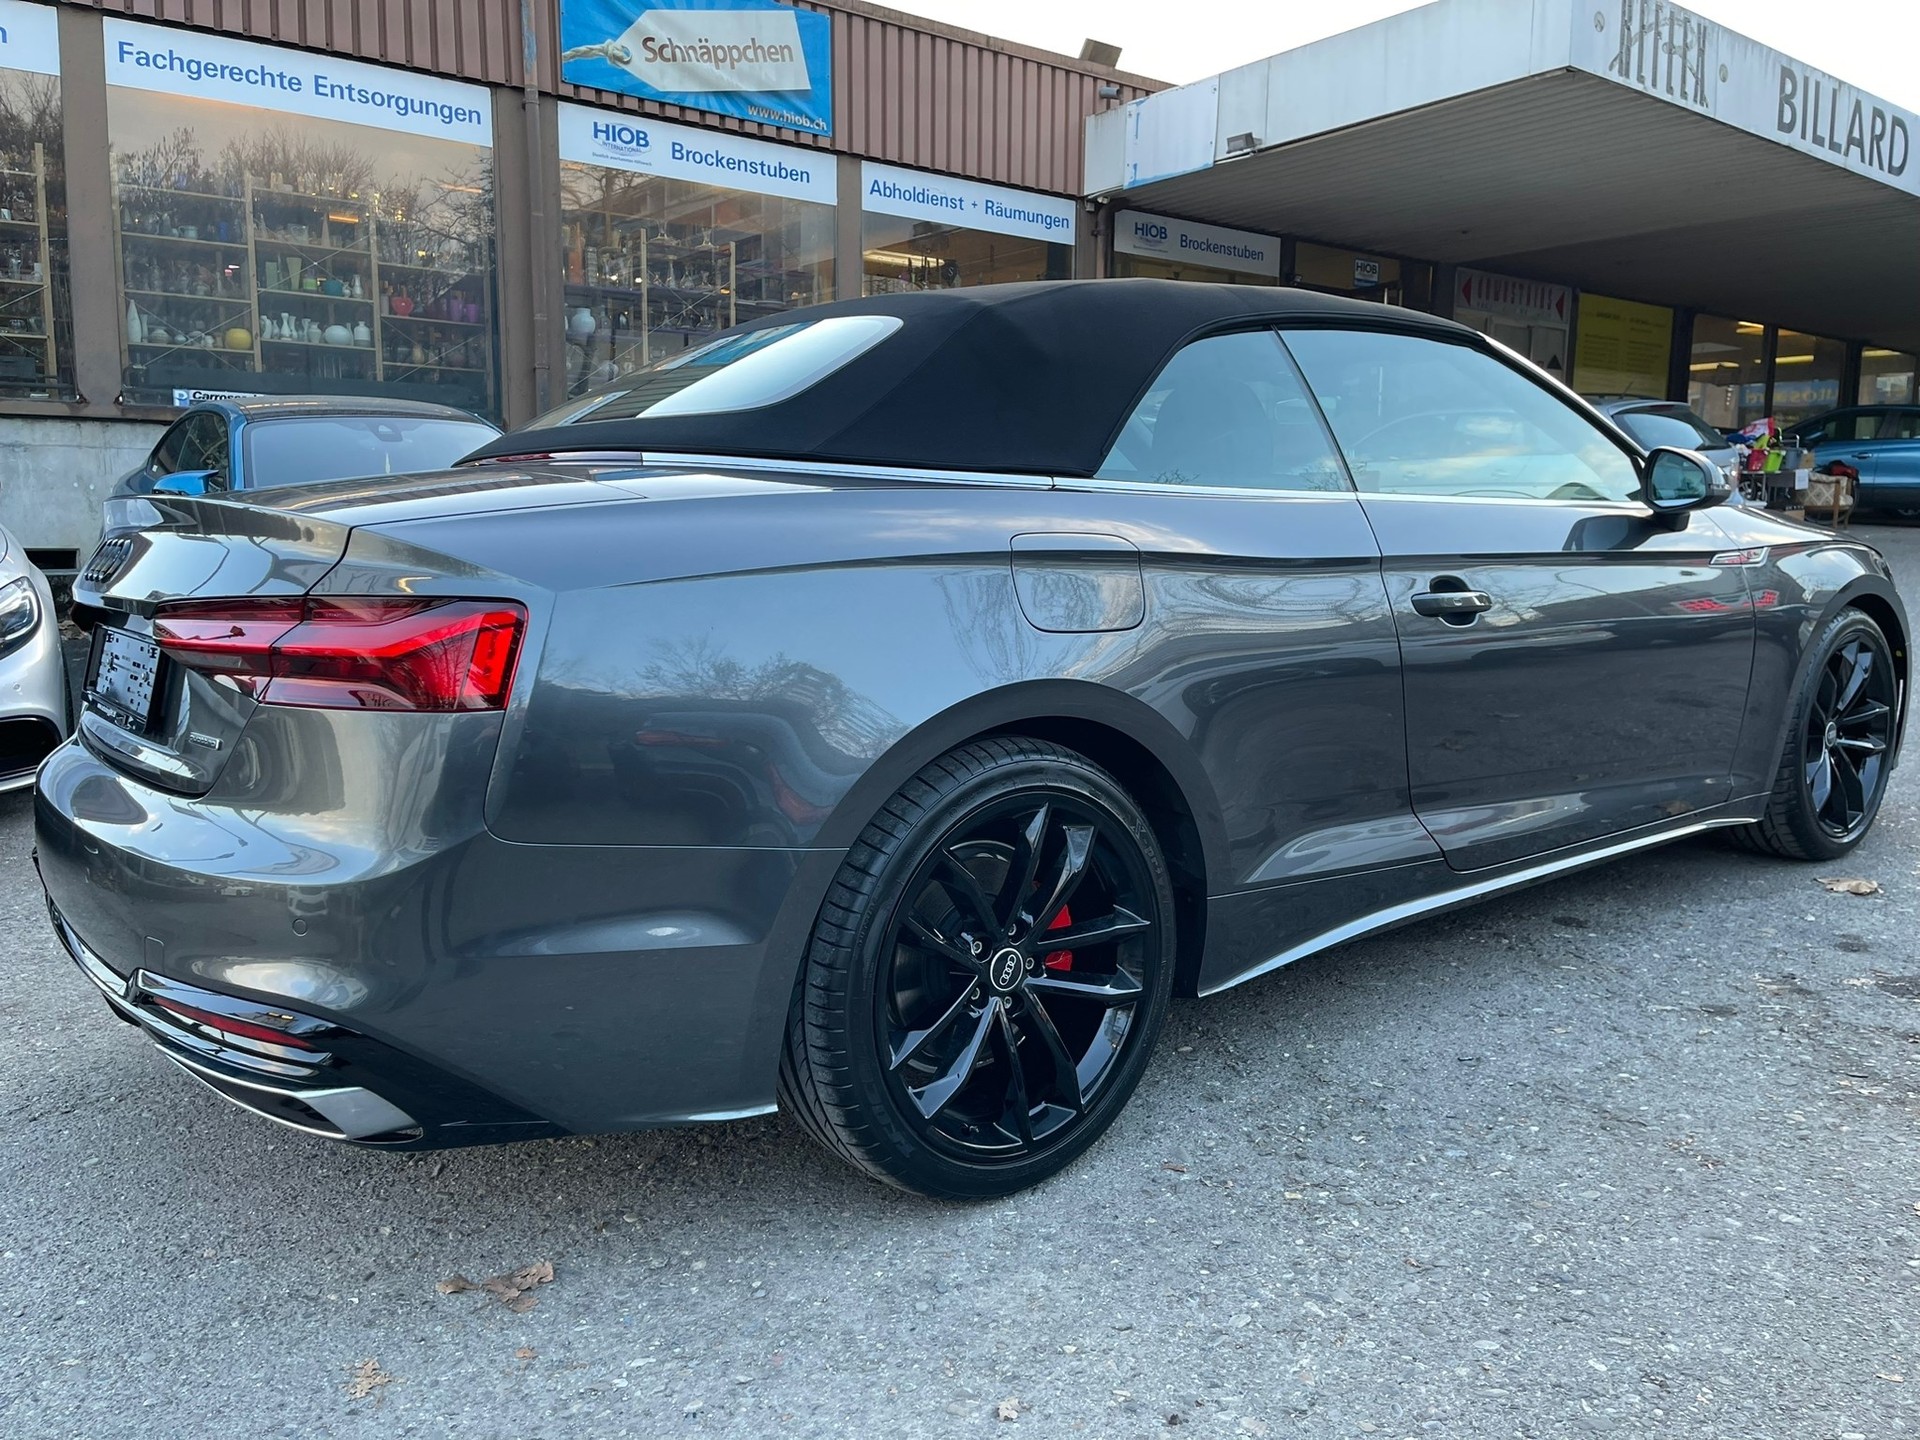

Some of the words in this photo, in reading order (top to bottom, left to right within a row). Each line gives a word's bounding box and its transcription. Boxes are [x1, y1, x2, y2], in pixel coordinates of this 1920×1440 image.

[642, 35, 794, 71] Schnäppchen
[117, 41, 302, 93] Fachgerechte
[313, 75, 482, 125] Entsorgungen
[593, 121, 650, 148] HIOB
[748, 104, 827, 131] www.hiob.ch
[1776, 64, 1909, 177] BILLARD
[671, 142, 811, 184] Brockenstuben
[870, 179, 964, 211] Abholdienst
[985, 198, 1070, 231] Räumungen
[1134, 222, 1168, 240] HIOB
[1180, 234, 1264, 261] Brockenstuben
